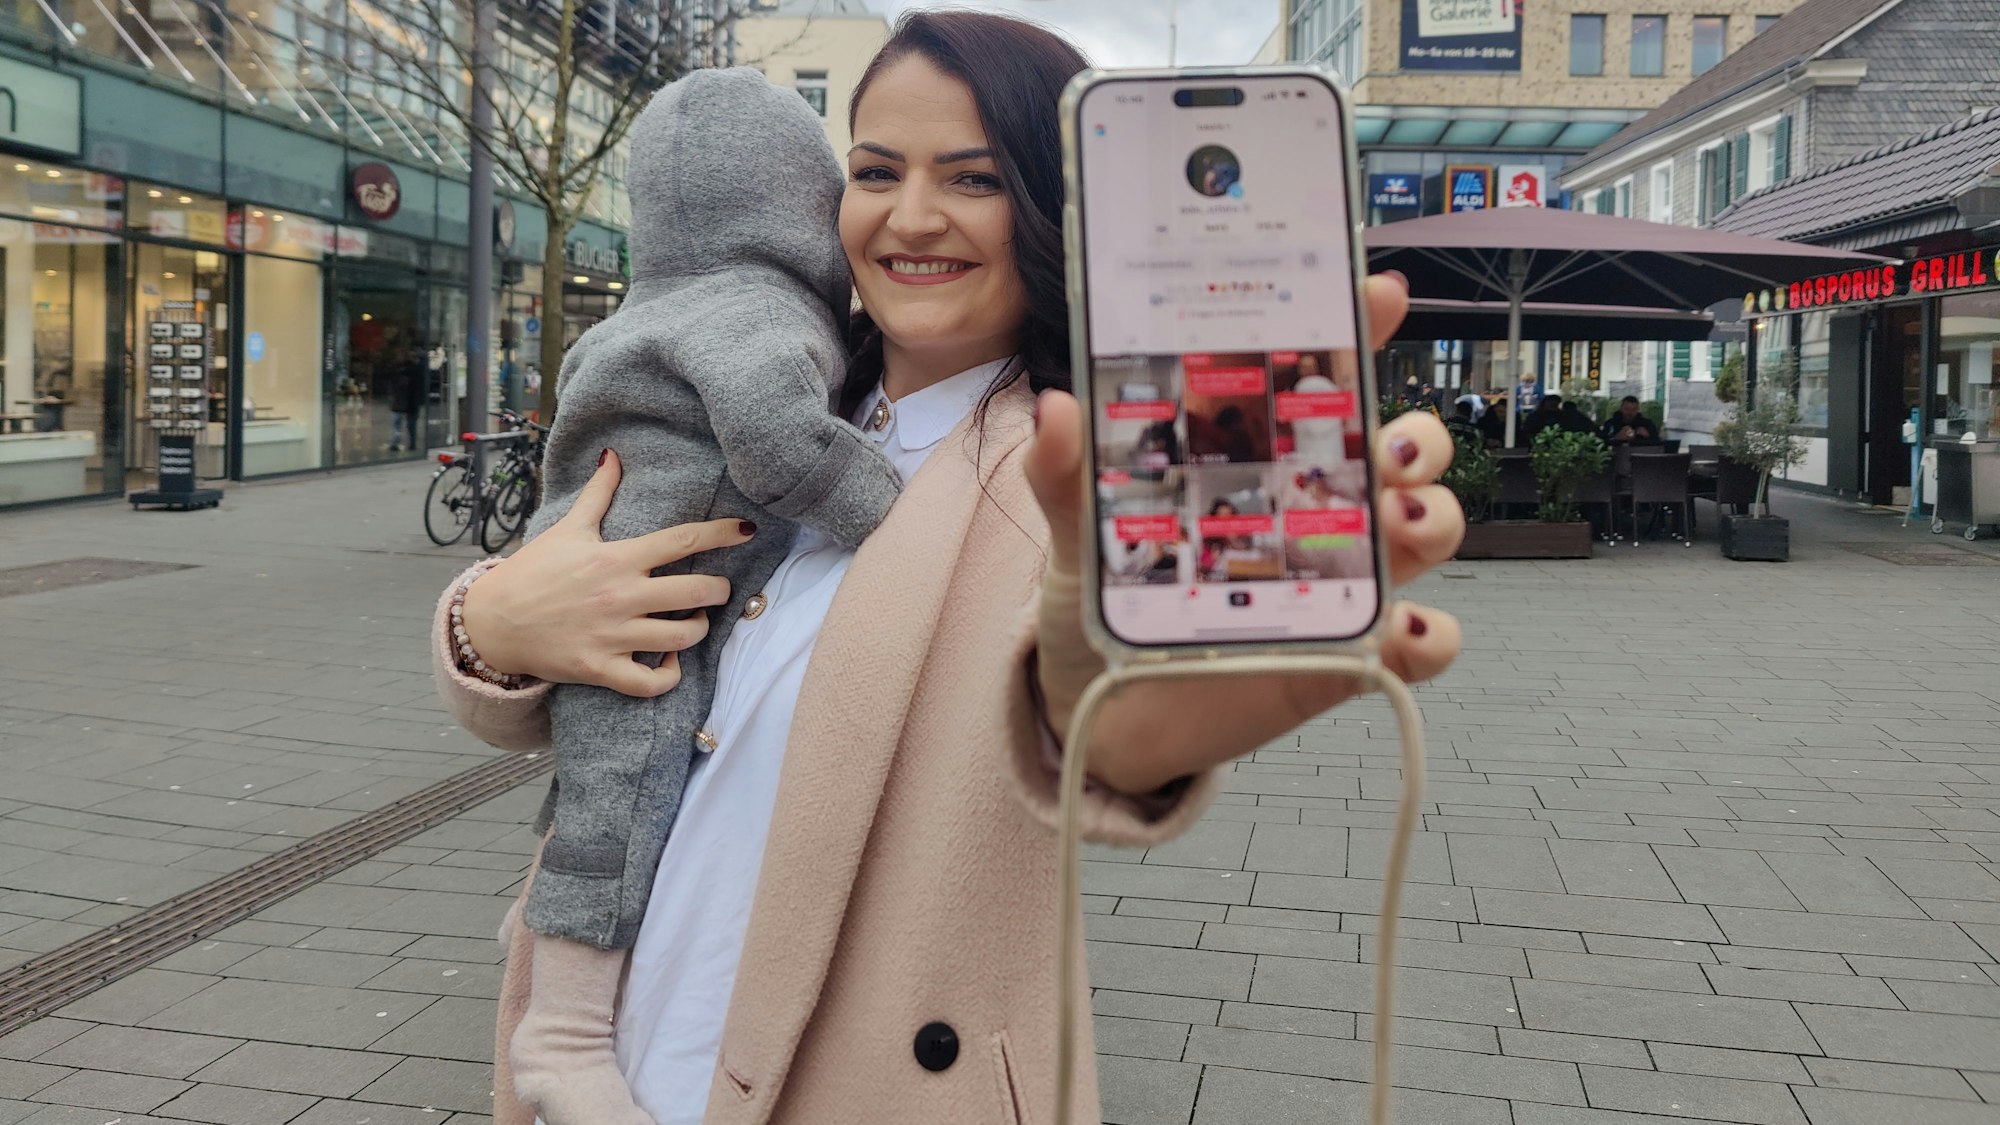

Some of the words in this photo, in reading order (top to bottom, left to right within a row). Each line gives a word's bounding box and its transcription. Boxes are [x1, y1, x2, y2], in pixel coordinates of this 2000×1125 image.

[1430, 6, 1492, 22] Galerie
[1373, 194, 1390, 205] VR
[1391, 194, 1417, 205] Bank
[1453, 195, 1484, 206] ALDI
[1788, 264, 1897, 310] BOSPORUS
[1911, 250, 1988, 292] GRILL
